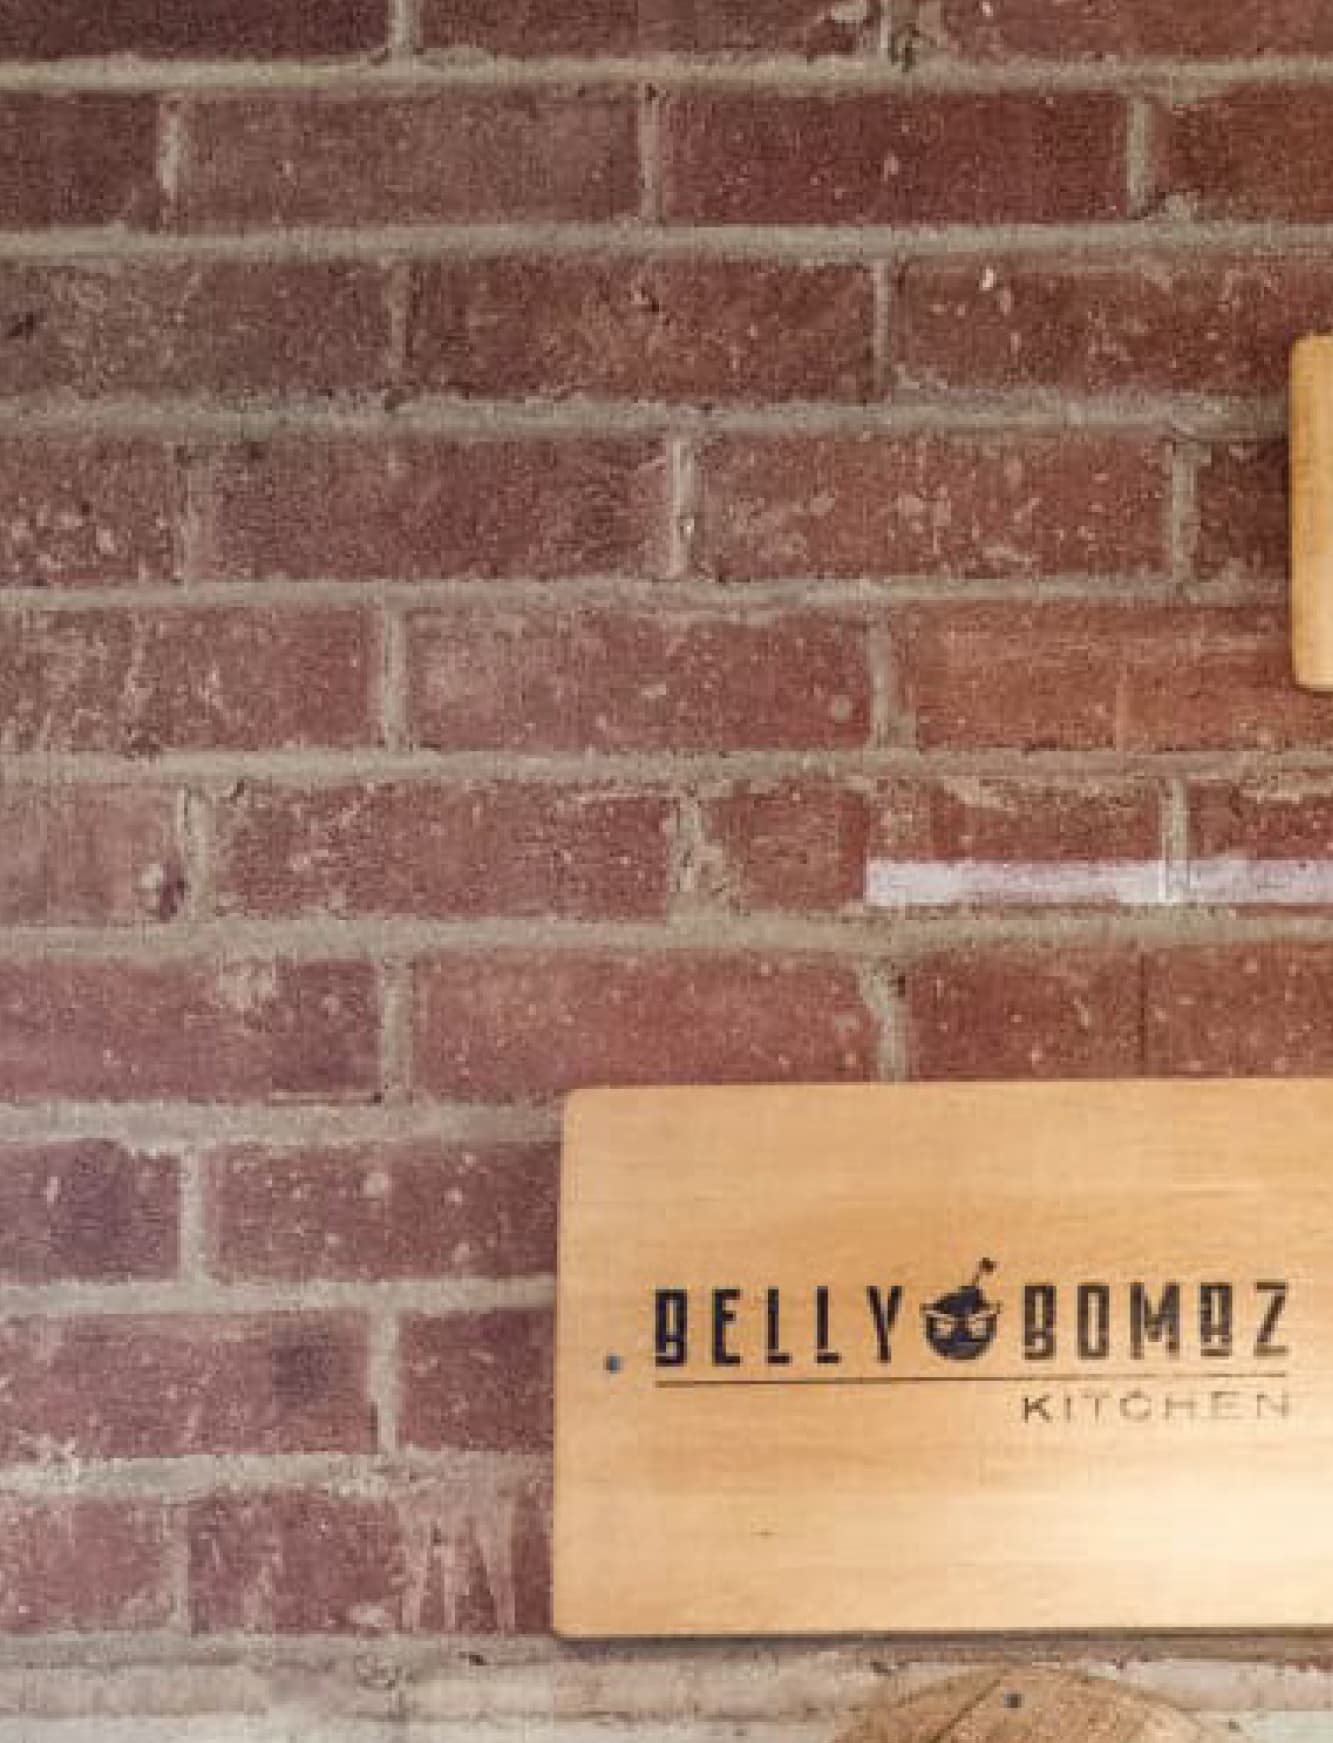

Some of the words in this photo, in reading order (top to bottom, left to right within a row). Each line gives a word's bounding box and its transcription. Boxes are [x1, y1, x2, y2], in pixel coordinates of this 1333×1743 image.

[654, 1284, 903, 1368] BELLY
[1022, 1280, 1290, 1362] BOMBZ
[1021, 1390, 1290, 1424] KITCHEN
